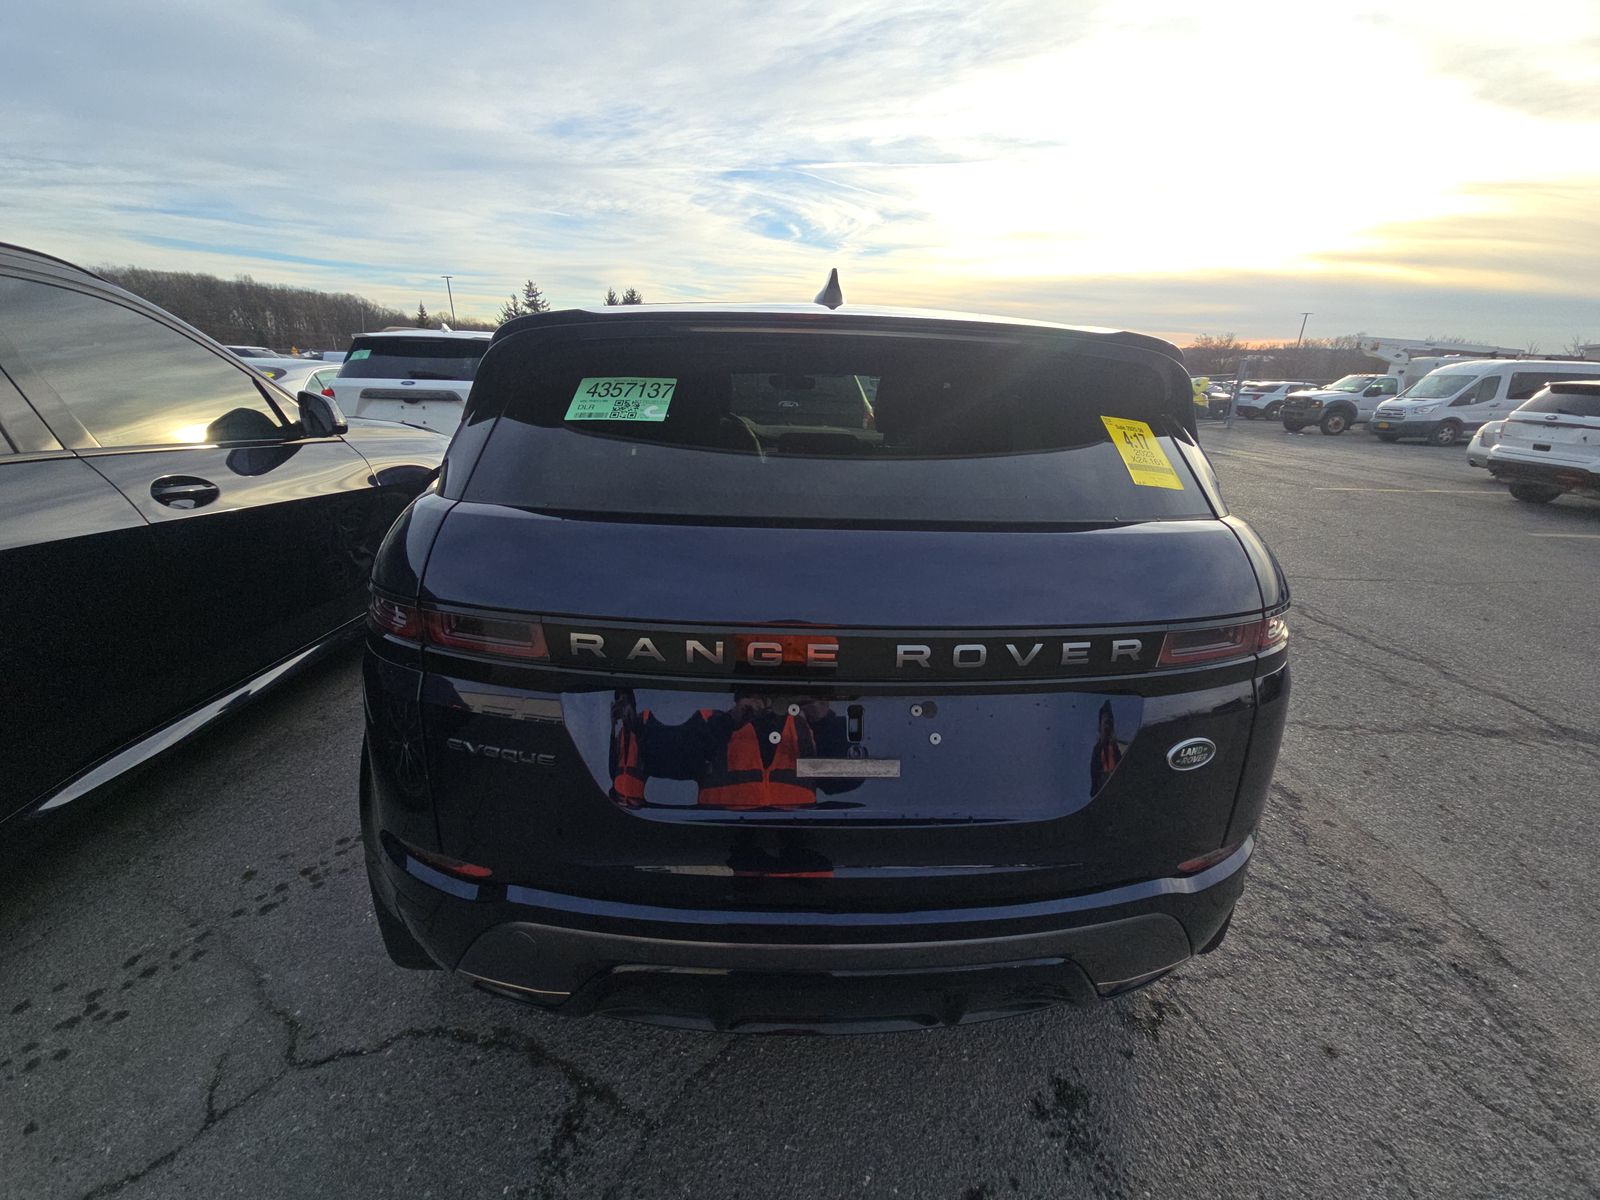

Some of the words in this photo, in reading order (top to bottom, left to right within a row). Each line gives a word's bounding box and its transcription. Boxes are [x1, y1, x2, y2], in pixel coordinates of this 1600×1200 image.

[586, 381, 675, 399] 4357137
[570, 632, 839, 667] RANGE
[896, 639, 1142, 668] ROVER
[447, 738, 556, 766] EVOQUE
[1180, 753, 1208, 765] ROVER
[1181, 746, 1203, 757] LAND
